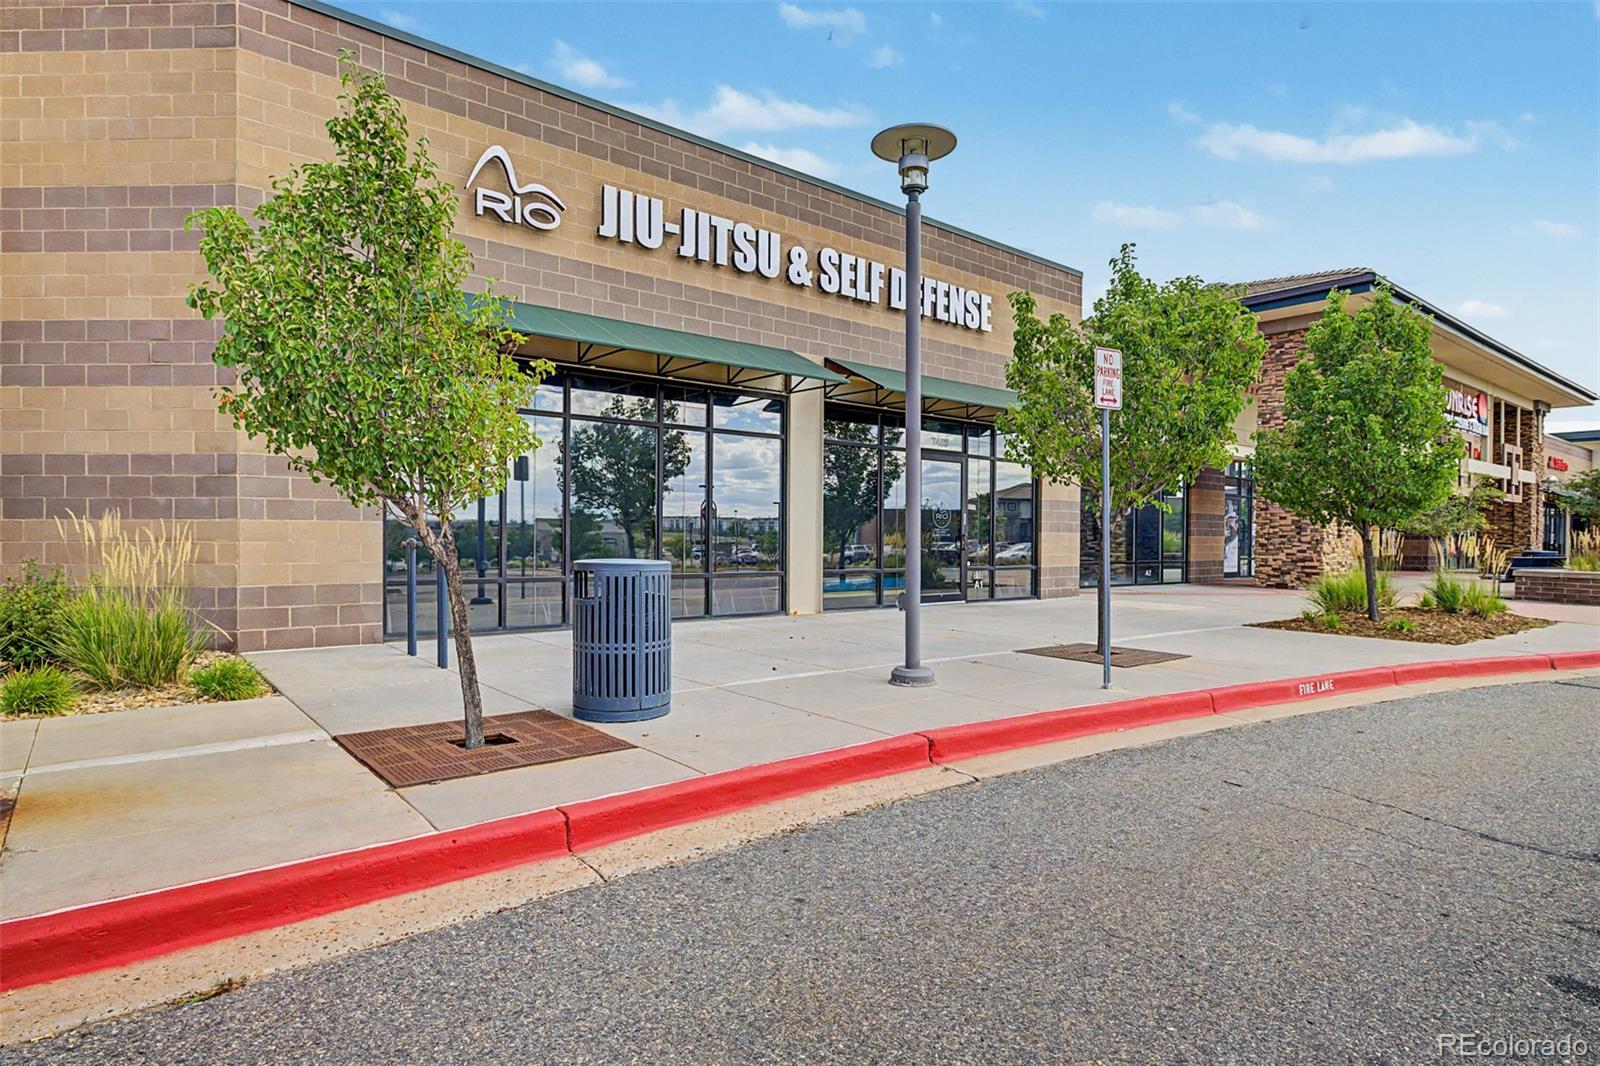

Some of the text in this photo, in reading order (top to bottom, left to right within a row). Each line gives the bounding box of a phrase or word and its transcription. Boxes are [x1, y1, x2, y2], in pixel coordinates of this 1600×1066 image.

[475, 187, 561, 230] RIO
[597, 184, 781, 279] JIU-JITSU
[786, 245, 813, 287] &
[817, 247, 885, 304] SELF
[1104, 354, 1113, 365] NO
[1097, 366, 1120, 379] PARKING
[1103, 379, 1114, 387] FIRE
[1102, 388, 1115, 397] LANE
[1445, 389, 1478, 417] UNRISE
[1299, 680, 1334, 695] FIRE LANE
